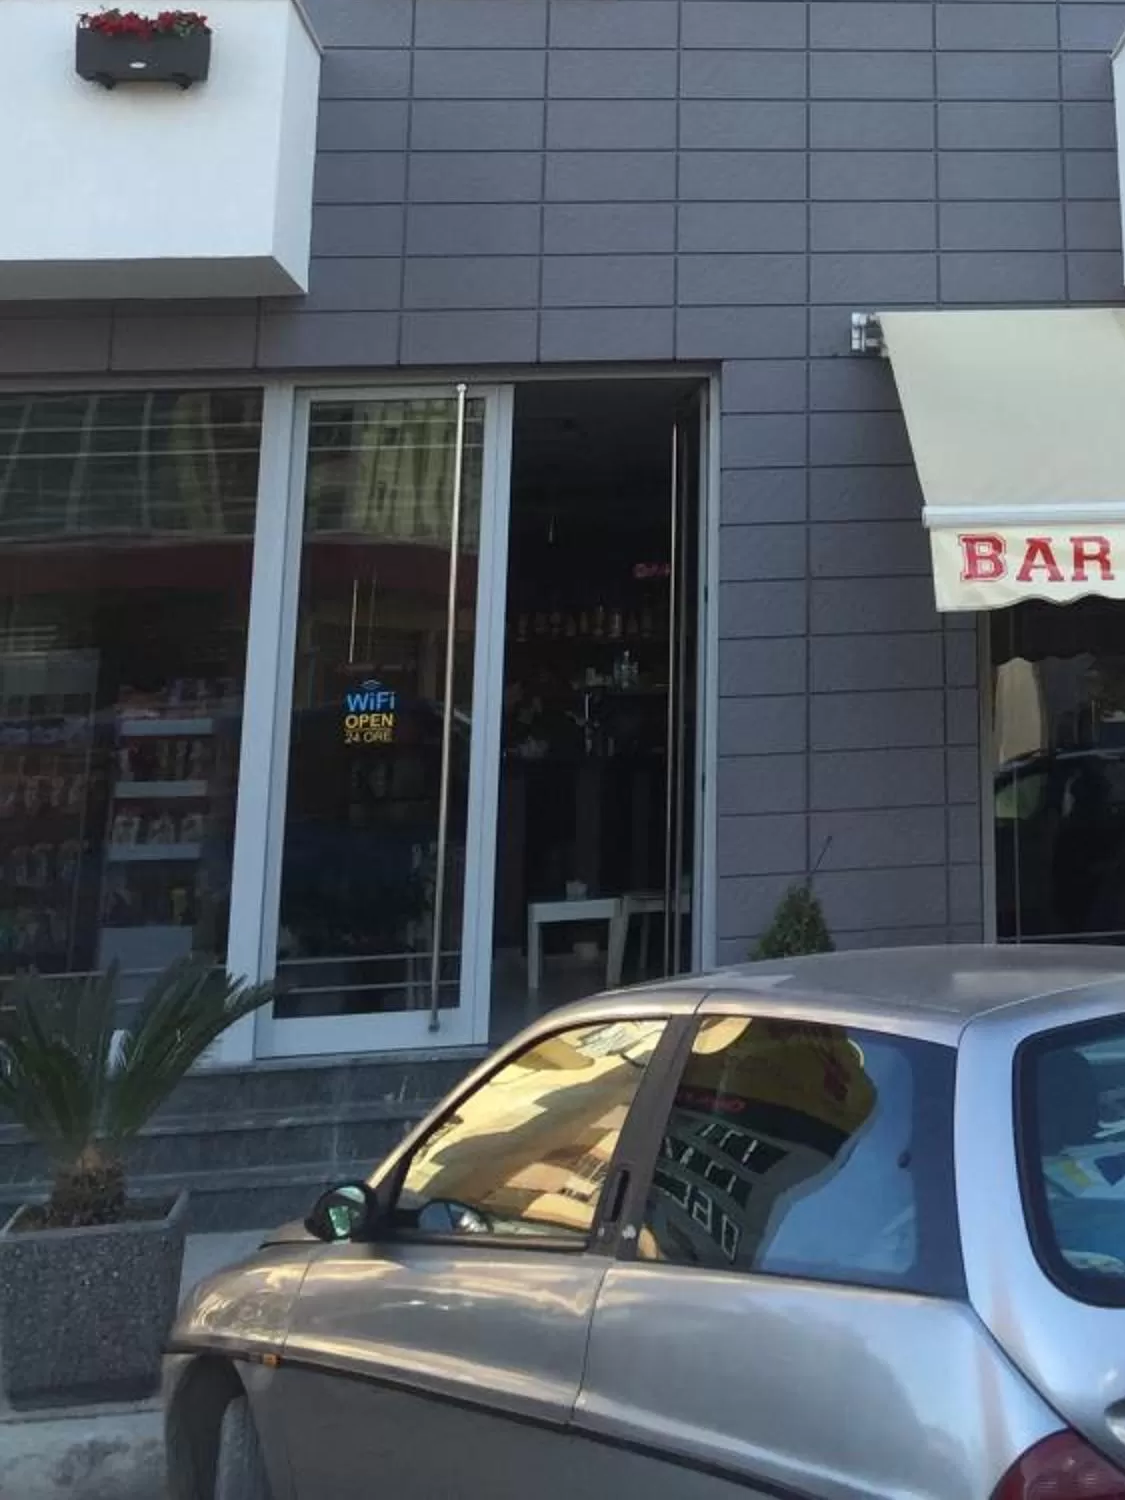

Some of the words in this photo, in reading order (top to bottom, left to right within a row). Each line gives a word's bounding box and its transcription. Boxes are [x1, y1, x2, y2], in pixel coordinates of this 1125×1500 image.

[959, 533, 1115, 583] BAR
[347, 691, 395, 711] WiFi
[345, 713, 393, 728] OPEN
